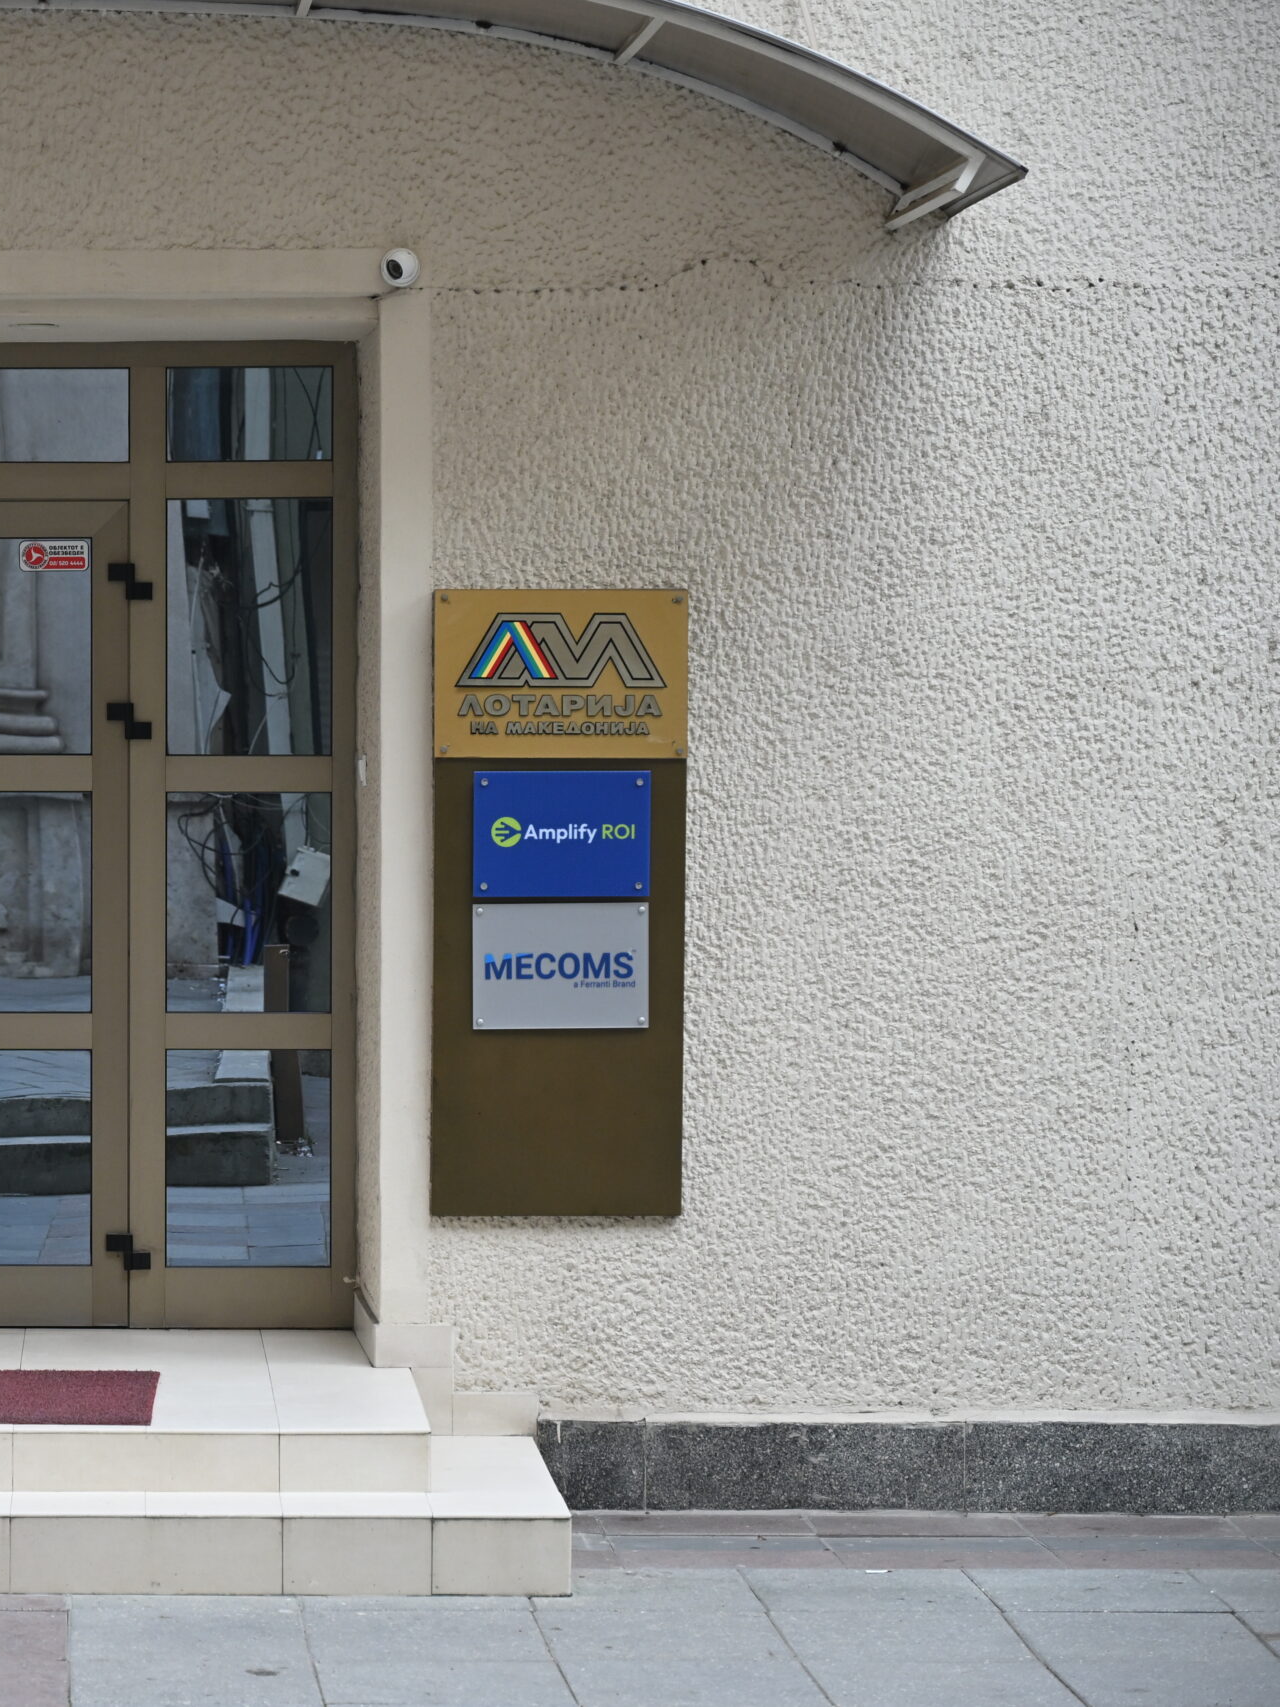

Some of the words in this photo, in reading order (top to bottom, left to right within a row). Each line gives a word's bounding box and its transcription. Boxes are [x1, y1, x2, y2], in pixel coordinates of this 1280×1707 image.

[457, 694, 663, 718] ЛОТАРИЈА
[470, 721, 499, 736] НА
[505, 721, 650, 736] МАКЕДОНИЈА
[524, 823, 597, 844] Amplify
[601, 823, 636, 840] ROI
[484, 952, 634, 980] MECOMS
[580, 980, 611, 988] Ferranti
[612, 980, 636, 988] Brand
